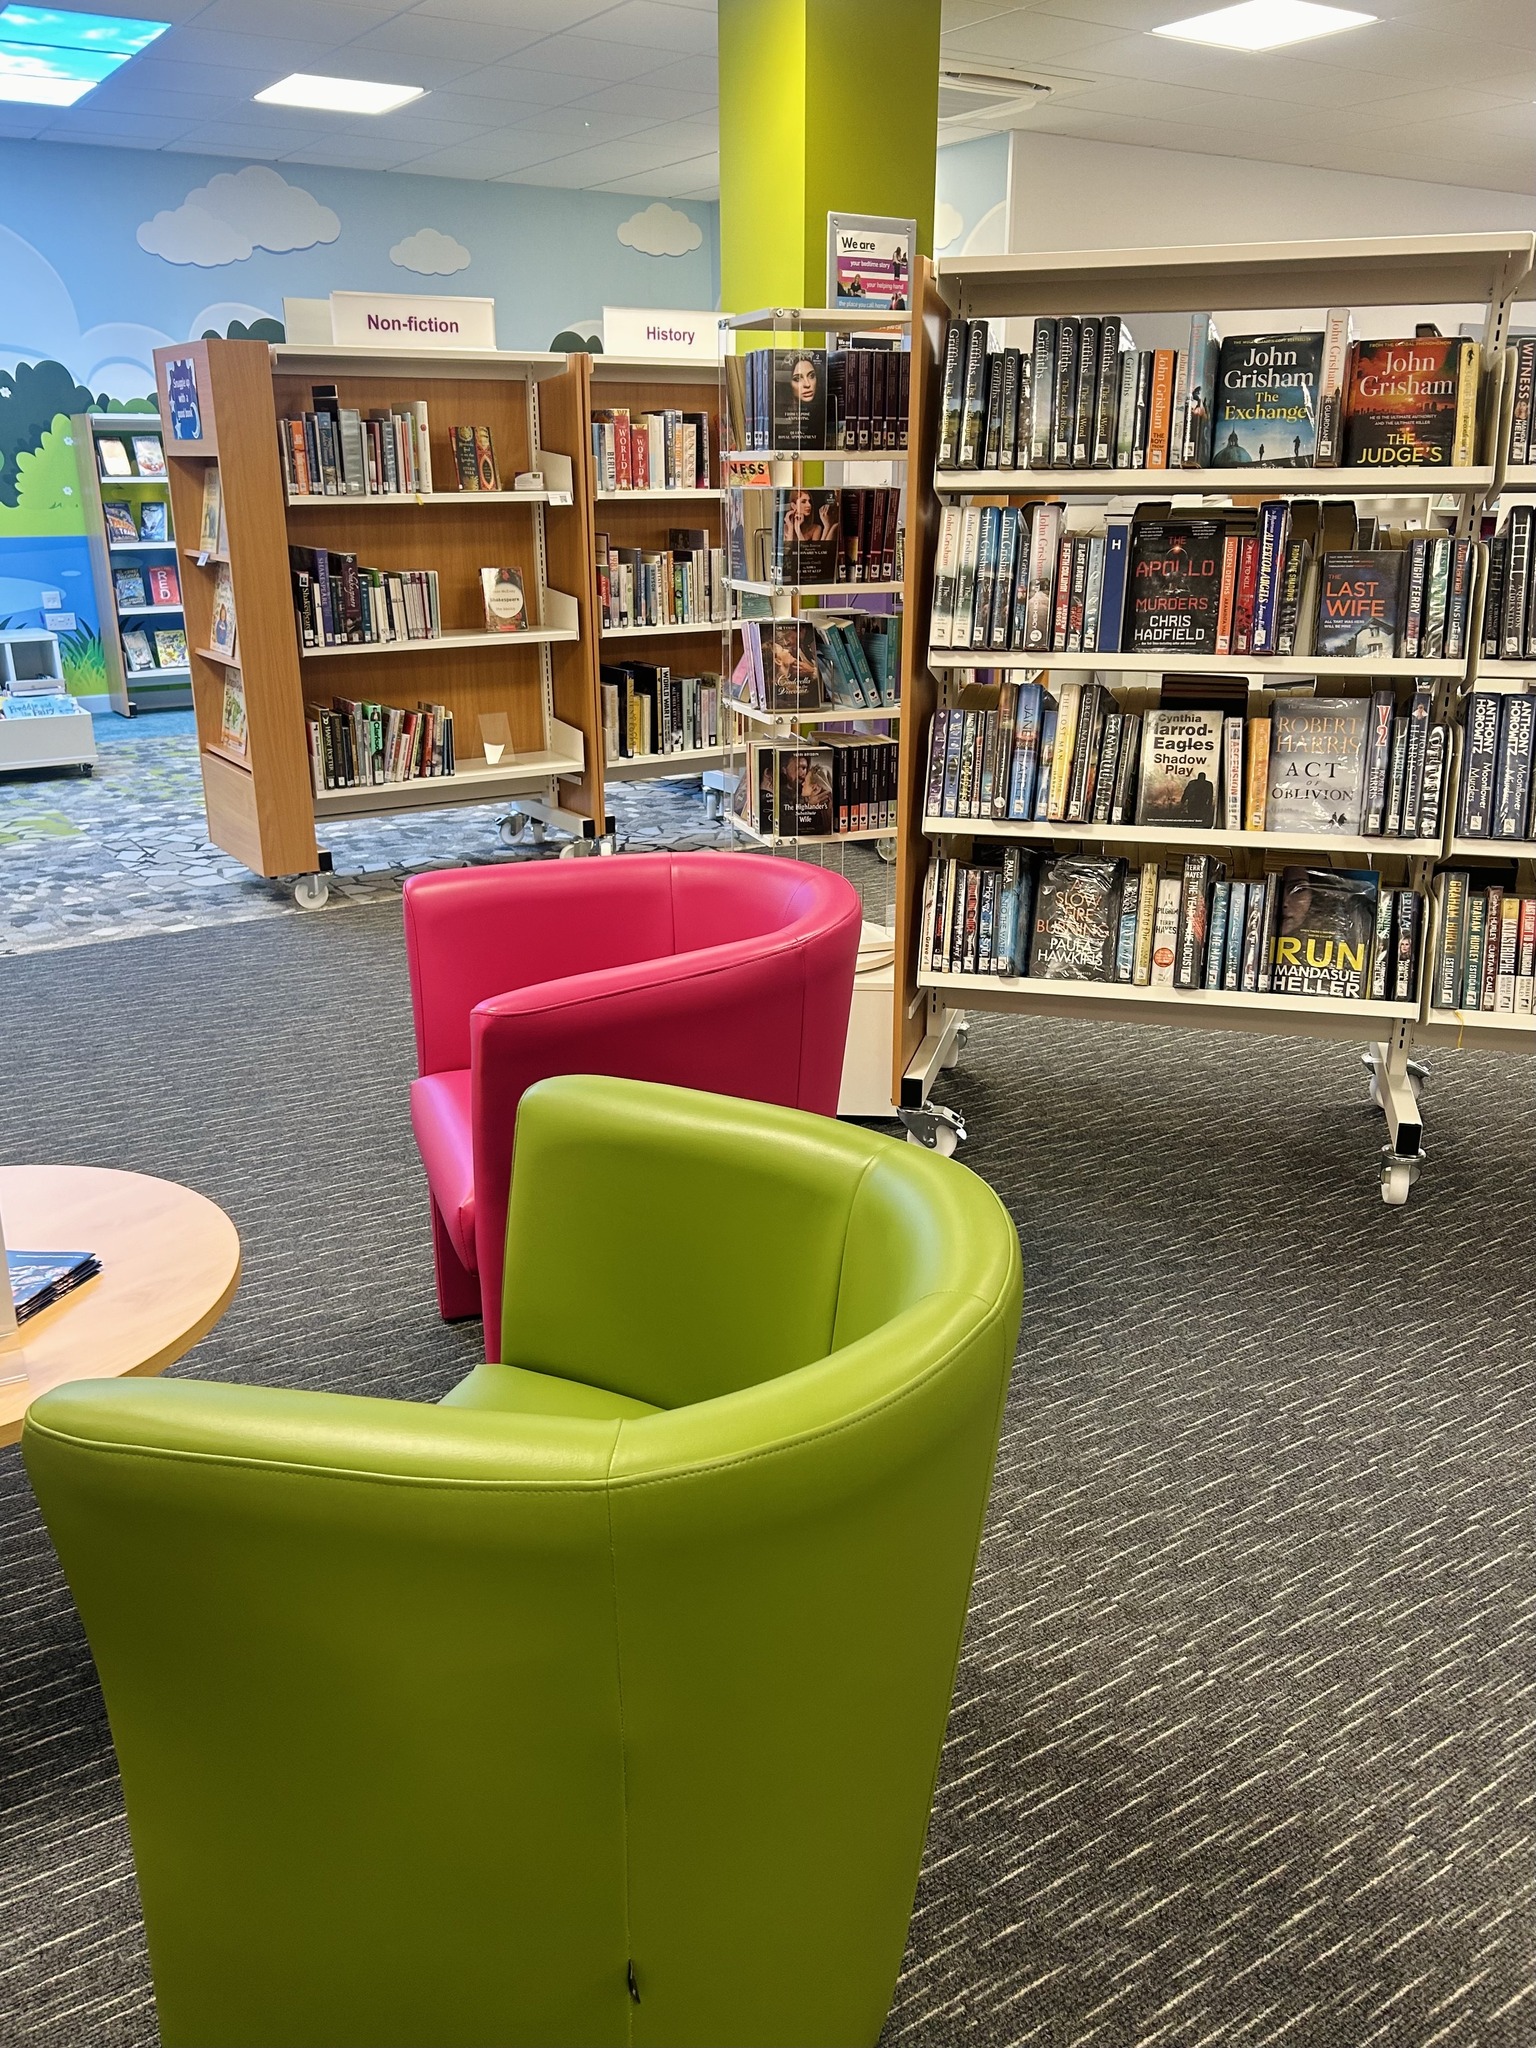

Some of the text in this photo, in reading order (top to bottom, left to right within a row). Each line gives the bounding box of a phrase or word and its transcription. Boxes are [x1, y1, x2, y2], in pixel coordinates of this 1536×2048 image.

[842, 237, 876, 250] We are
[367, 313, 460, 334] Non-fiction
[646, 326, 695, 345] History
[948, 328, 959, 374] Griffiths
[969, 330, 982, 375] Griffiths
[1036, 330, 1049, 378] Griffiths
[1061, 326, 1074, 372] Griffiths
[1082, 327, 1094, 373] Griffiths
[1103, 326, 1115, 372] Griffiths
[1244, 346, 1296, 367] John
[1327, 318, 1343, 389] John Grisham
[1006, 356, 1015, 395] Griffiths
[1124, 357, 1134, 396] Griffiths
[1382, 352, 1435, 375] John
[1518, 343, 1534, 399] WITNESS
[992, 361, 1002, 398] Griffiths
[1154, 354, 1168, 429] John Grisham
[1224, 368, 1314, 389] Grisham
[1359, 375, 1453, 397] Grisham
[1255, 391, 1279, 402] The
[1225, 403, 1307, 423] Exchange
[618, 428, 628, 470] WORLD
[1387, 434, 1416, 445] THE
[607, 452, 616, 479] BERLIN
[636, 438, 644, 476] WORLD
[1357, 448, 1442, 464] JUDGE'S
[943, 514, 954, 566] John Grisham
[964, 514, 975, 567] John Grisham
[978, 514, 992, 581] John Grisham
[999, 514, 1014, 581] John Grisham
[1036, 514, 1050, 578] John Grisham
[1112, 539, 1121, 550] H
[1168, 536, 1187, 545] THE
[318, 557, 327, 606] SHAKESPEARE
[1060, 548, 1071, 592] FIFTH COLUMN
[1075, 548, 1086, 593] LAST BROTHER
[1136, 560, 1214, 577] APOLLO
[1224, 570, 1232, 594] DEPTHS
[1413, 558, 1423, 583] NIGHT
[158, 571, 170, 599] RED
[1287, 574, 1296, 601] SHADOWS
[1326, 582, 1379, 596] LAST
[302, 588, 310, 630] Shakespeare
[1136, 598, 1208, 611] MURDERS
[1326, 600, 1385, 617] WIFE
[1411, 586, 1421, 614] FERRY
[1149, 615, 1191, 627] CHRIS
[1452, 598, 1461, 640] INSIDER
[1134, 629, 1205, 641] HADFIELD
[8, 702, 38, 714] Freddie
[33, 708, 55, 716] Fairy
[1158, 714, 1202, 723] Cynthia
[1023, 705, 1033, 740] JANE
[1278, 717, 1361, 734] ROBERT
[1375, 705, 1390, 746] V2
[1472, 699, 1486, 754] HOROWITZ
[1483, 700, 1496, 754] ANTHONY
[1507, 700, 1522, 756] HOROWITZ
[1518, 701, 1532, 756] ANTHONY
[1079, 728, 1088, 763] NATURE
[1154, 737, 1214, 752] Eagles
[1276, 734, 1361, 754] HARRIS
[1408, 725, 1420, 771] HARRIS
[1154, 754, 1207, 765] Shadow
[1165, 765, 1194, 777] Play
[1230, 741, 1240, 795] ASCENSION
[1286, 762, 1341, 778] ACT
[1272, 788, 1354, 801] OBLIVION
[1370, 767, 1379, 799] HARRIS
[1469, 767, 1480, 801] Murders
[1480, 762, 1492, 809] Moonflower
[1514, 764, 1527, 810] Moonflower
[796, 803, 828, 811] Highlander's
[1056, 891, 1102, 907] SLOW
[1071, 880, 1081, 891] A
[1036, 920, 1110, 937] BURNING
[1065, 908, 1094, 921] FIRE
[1182, 881, 1198, 969] THE LOCUST
[1156, 926, 1177, 934] HAYES
[1444, 880, 1462, 990] GRAHAM HURLEY ESTOCADA
[1469, 900, 1482, 962] GRAHAM HURLEY
[1038, 949, 1103, 966] HAWKINS
[1050, 938, 1091, 952] PAULA
[1276, 936, 1364, 971] RUN
[1487, 917, 1499, 974] HURLEY CURTAIN
[1500, 920, 1517, 974] KATASTROPHE
[1521, 942, 1533, 975] STALINGRAD
[1273, 976, 1360, 997] HELLER
[1275, 965, 1360, 983] MANDASUE
